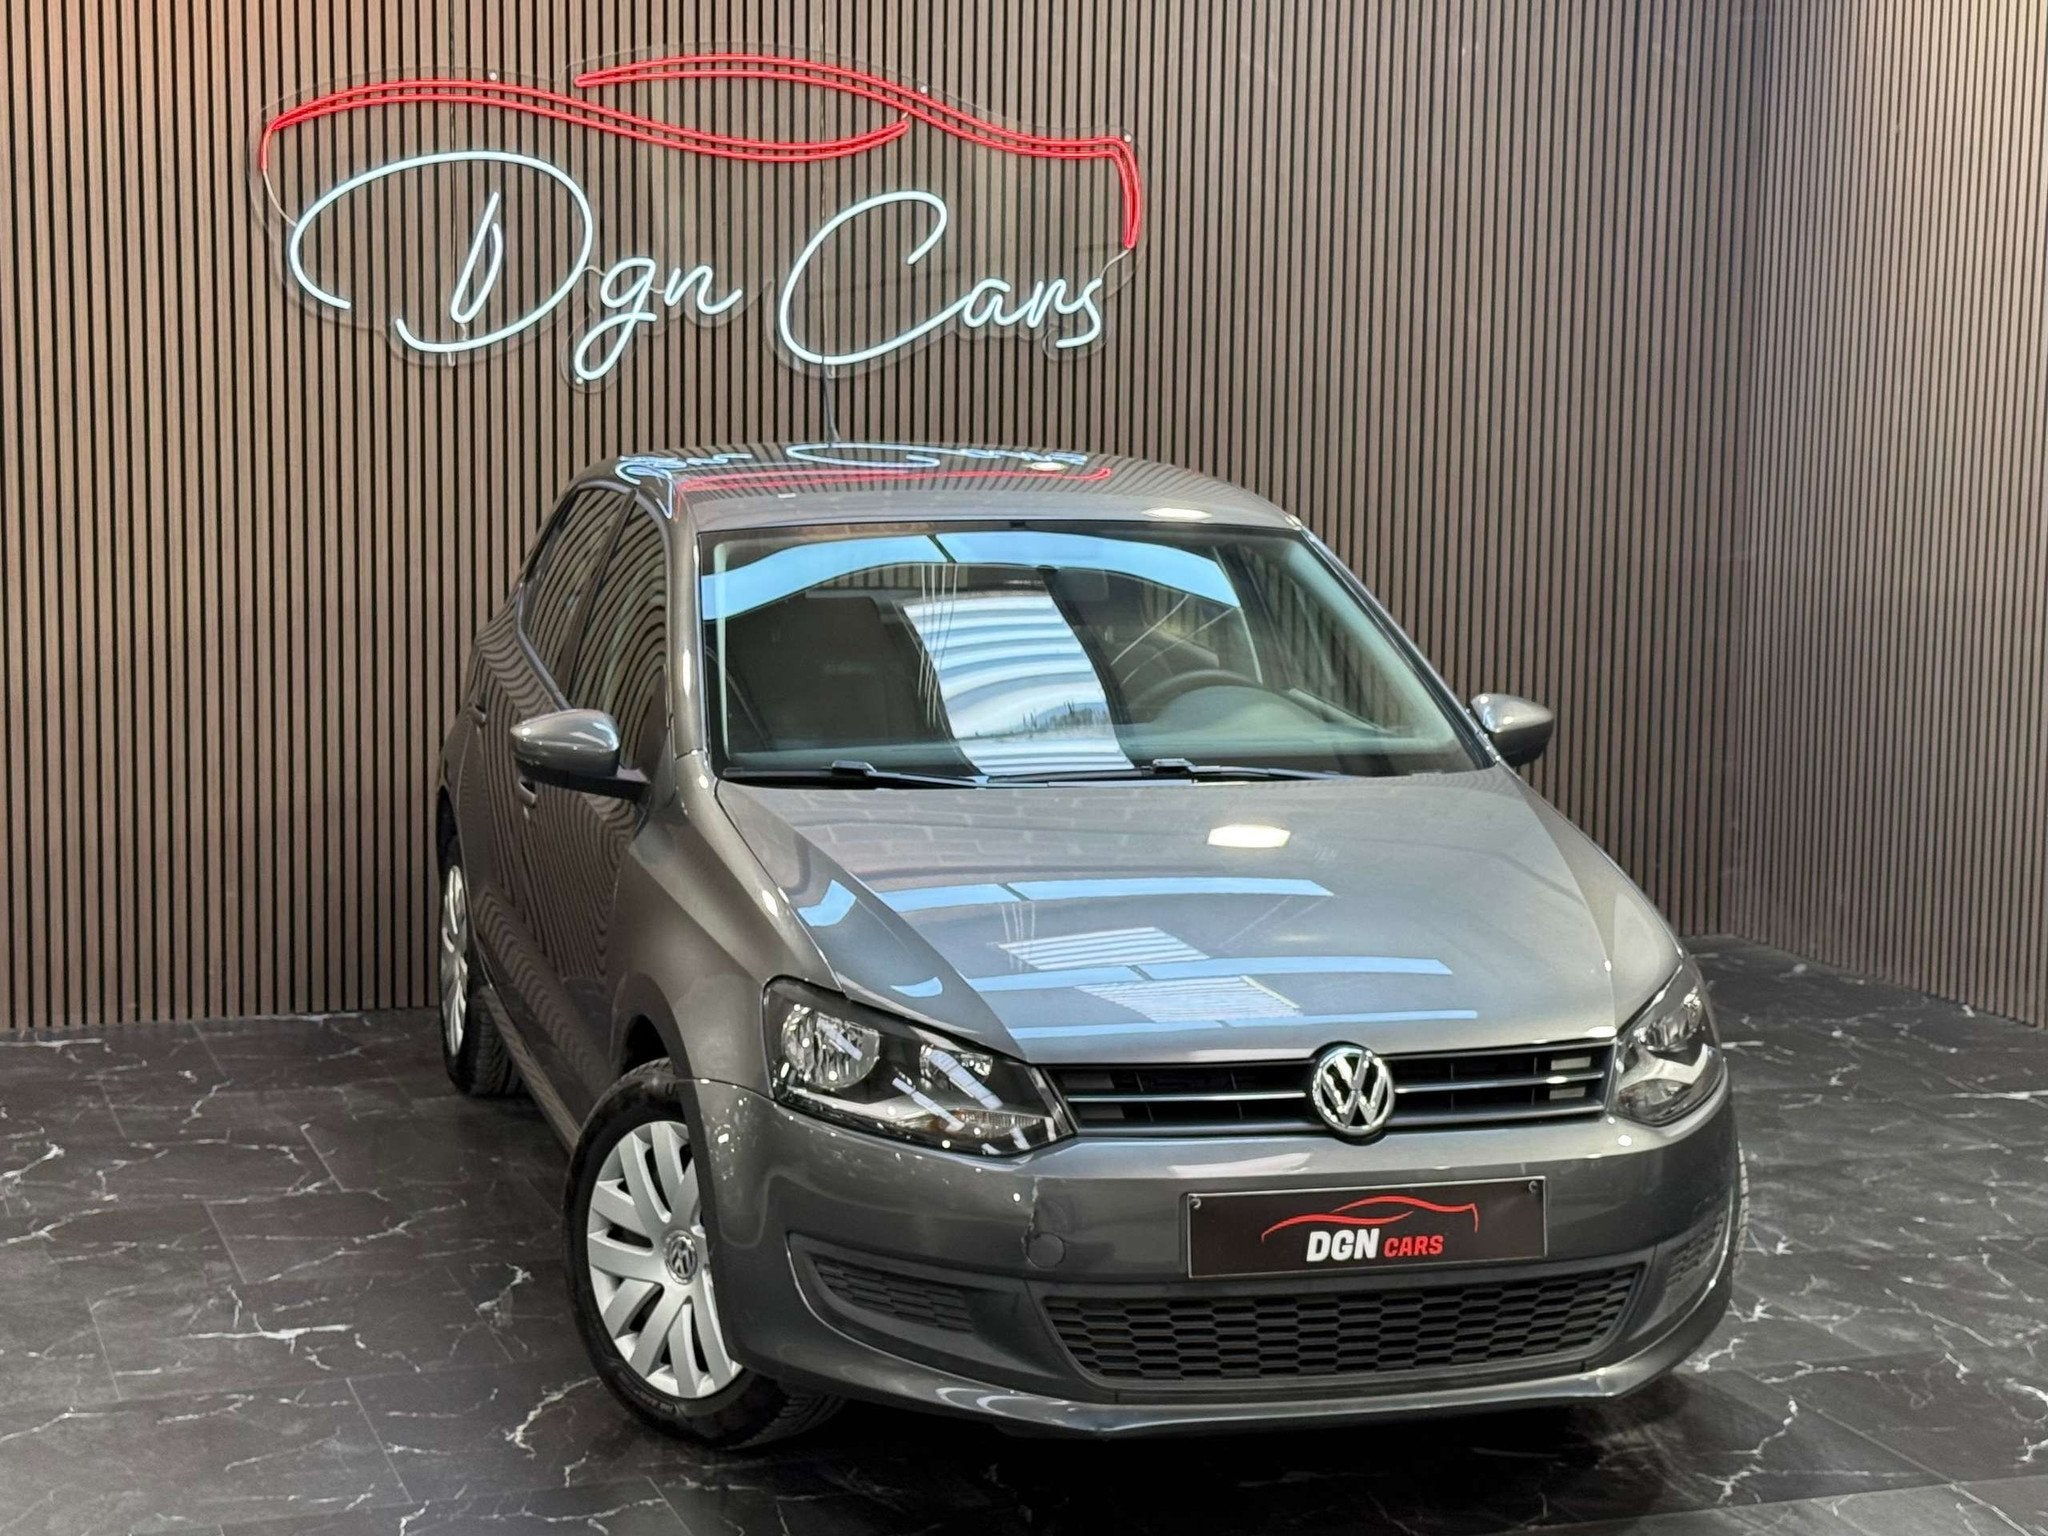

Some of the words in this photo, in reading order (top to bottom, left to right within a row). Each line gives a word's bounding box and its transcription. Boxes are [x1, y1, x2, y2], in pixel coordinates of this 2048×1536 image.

[288, 151, 742, 382] Dgn
[780, 190, 1104, 366] Cars
[1318, 1050, 1390, 1130] VW
[1306, 1228, 1380, 1262] DGN
[1383, 1235, 1444, 1258] CARS
